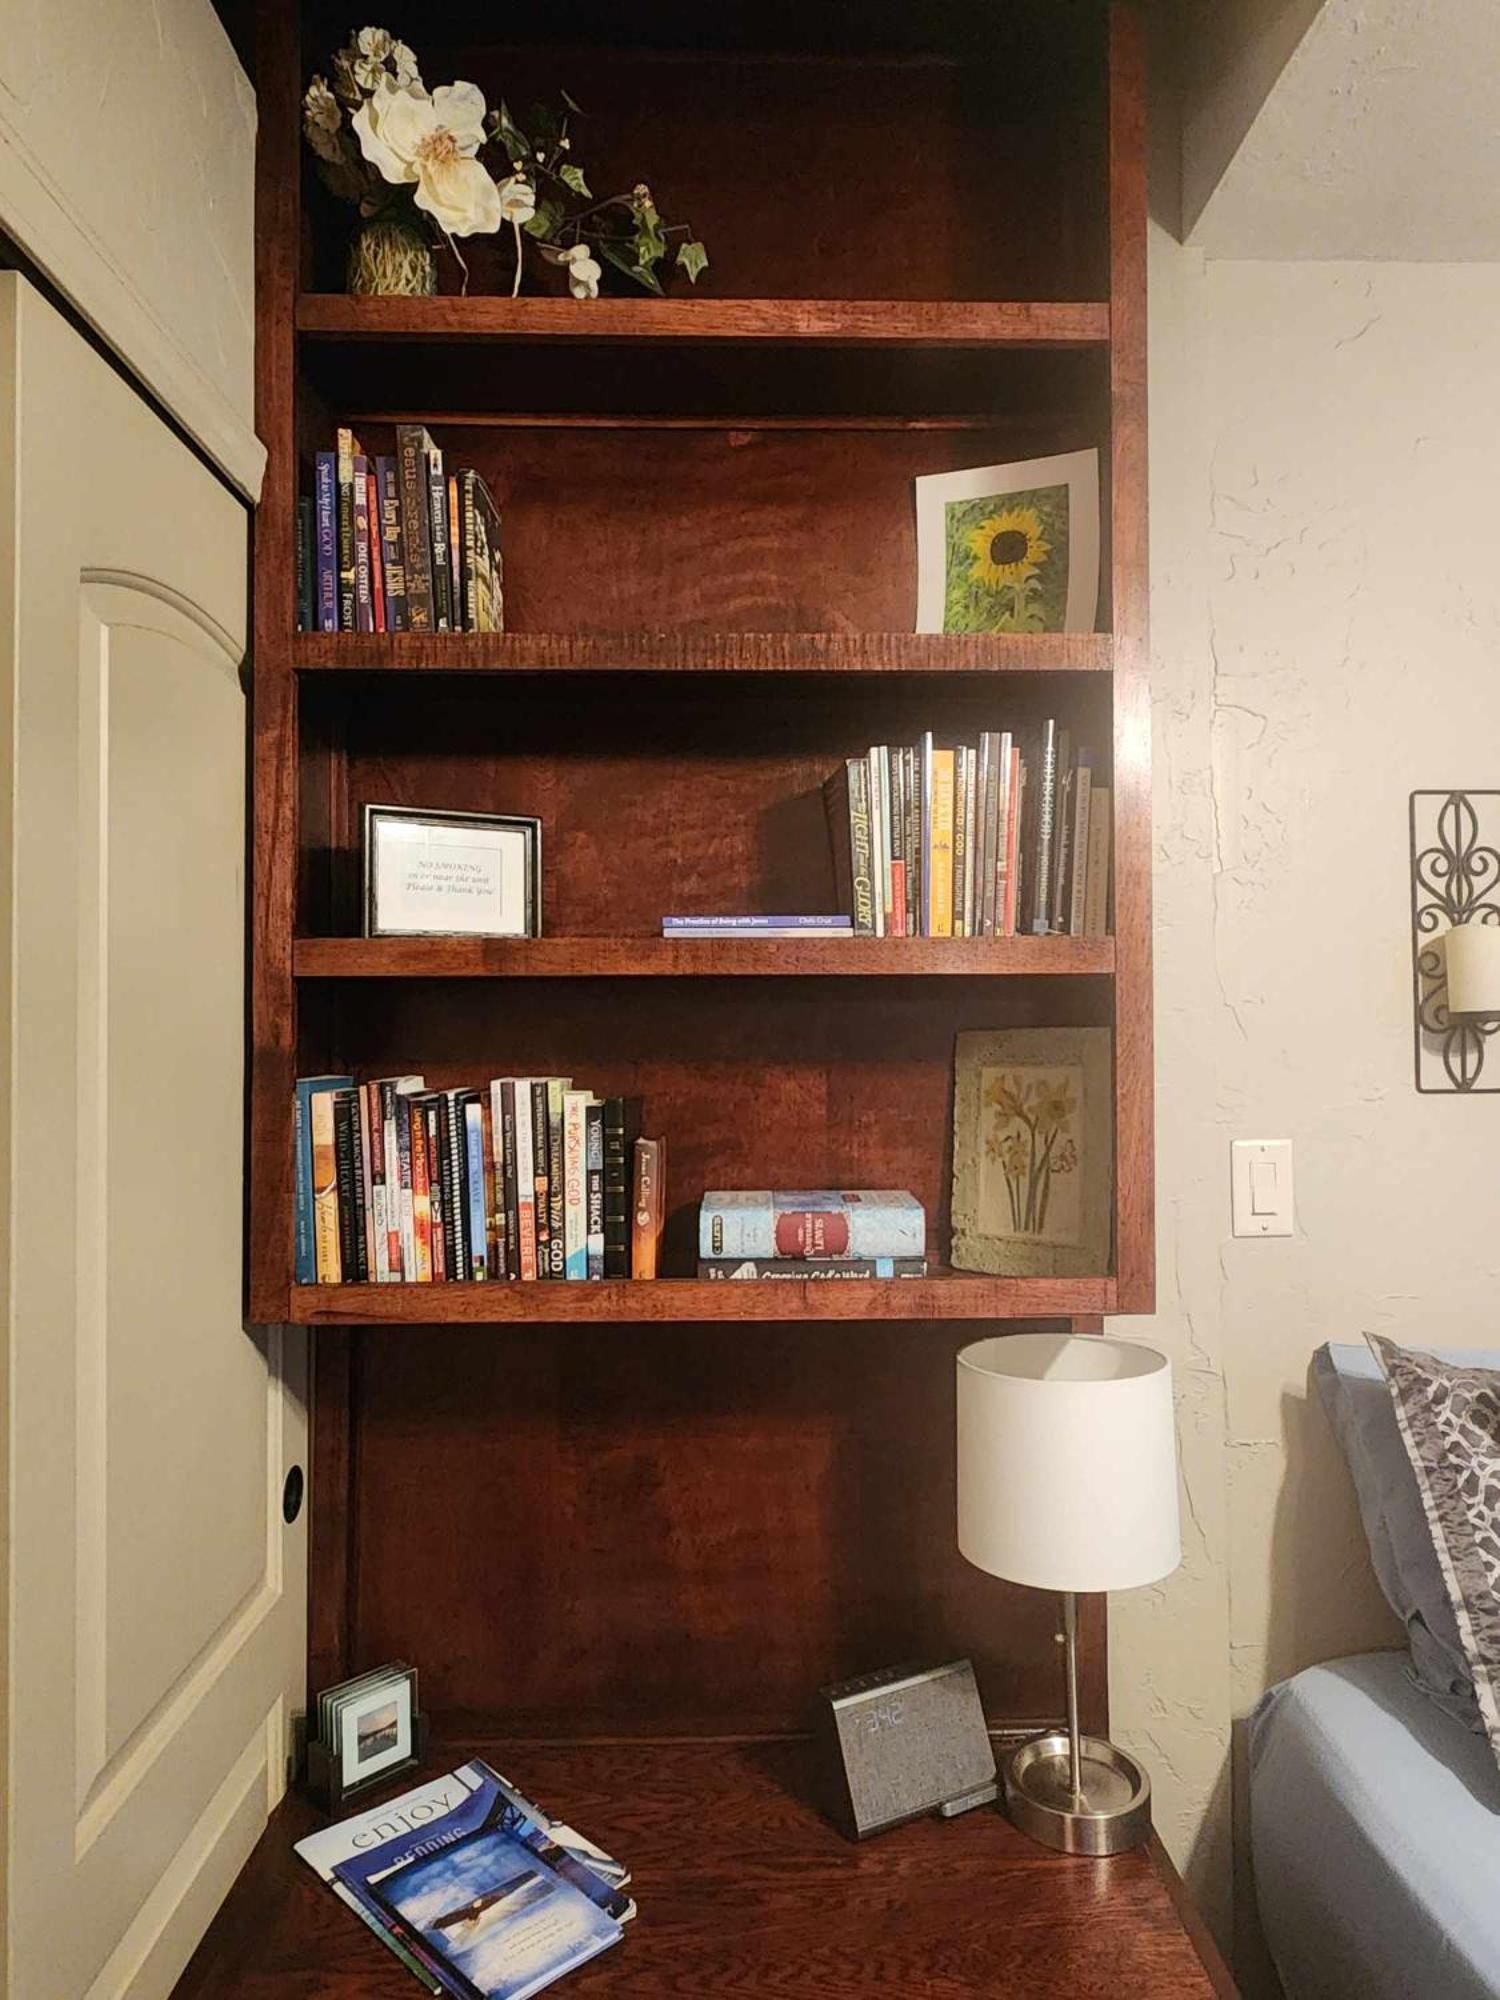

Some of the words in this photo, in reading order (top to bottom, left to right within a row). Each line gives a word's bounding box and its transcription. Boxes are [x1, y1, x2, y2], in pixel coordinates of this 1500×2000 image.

[403, 431, 424, 490] Jesus
[382, 499, 401, 523] Every
[432, 485, 445, 524] Heaven
[465, 493, 475, 546] BARBARIAN
[383, 525, 402, 542] Day
[356, 542, 367, 563] JOEL
[434, 542, 447, 565] Real
[466, 549, 476, 568] WAY
[321, 568, 334, 608] ARTHUR
[358, 564, 369, 603] OSTEEN
[385, 563, 406, 596] JESUS
[342, 592, 353, 627] FROST
[850, 810, 869, 857] LIGHT
[893, 839, 902, 857] PLAN
[955, 833, 964, 856] GOD
[418, 861, 433, 870] NO
[434, 861, 482, 874] SMOKING
[854, 876, 873, 929] GLORY
[413, 1107, 423, 1130] Living
[536, 1096, 545, 1149] SUPERNATURAL
[569, 1101, 579, 1118] THE
[338, 1121, 350, 1152] WILD
[415, 1139, 424, 1152] the
[568, 1121, 582, 1175] PURSUING
[589, 1119, 602, 1158] YOUNG
[340, 1160, 351, 1197] HEART
[400, 1151, 411, 1188] STATIC
[415, 1152, 427, 1196] Miraculous
[550, 1135, 562, 1192] DREAMING
[640, 1151, 651, 1176] Jesus
[567, 1178, 581, 1206] GOD
[591, 1174, 600, 1191] THE
[638, 1176, 651, 1208] Calling
[550, 1194, 563, 1229] With
[589, 1192, 602, 1234] SHACK
[521, 1210, 533, 1264] BEVERE
[803, 1212, 815, 1256] QUOTABLE
[814, 1218, 825, 1251] LEWIS
[357, 1235, 366, 1270] NANCE
[550, 1238, 564, 1272] GOD
[351, 1793, 452, 1849] enjoy
